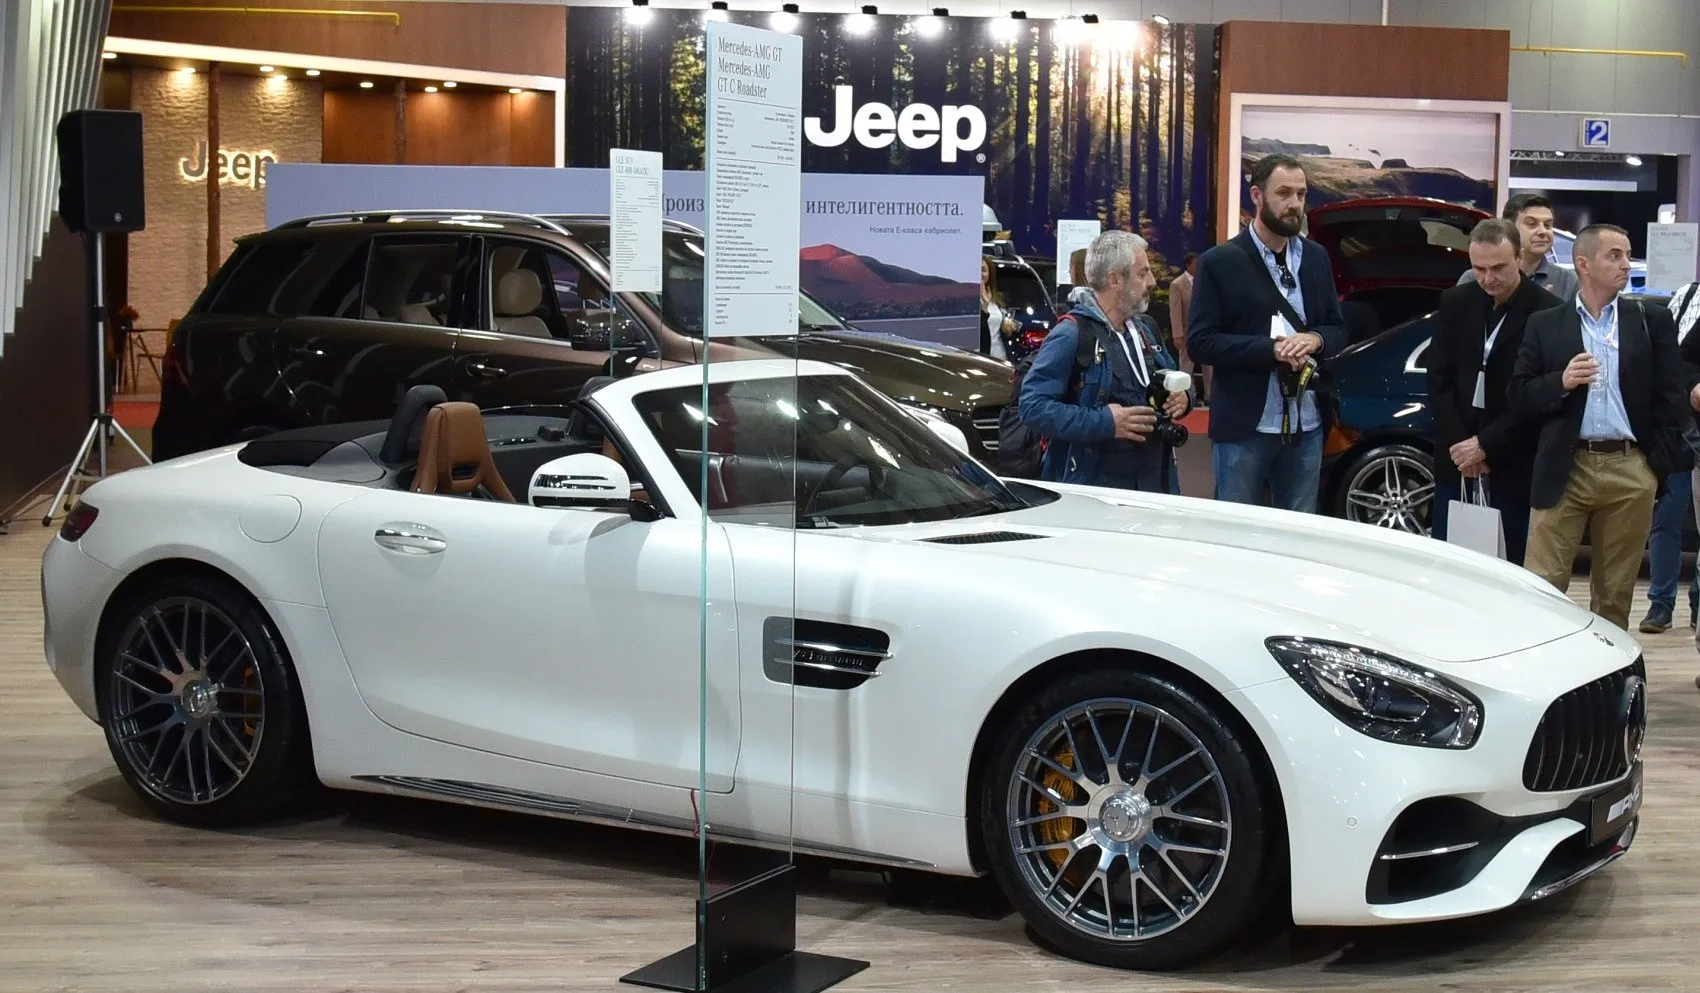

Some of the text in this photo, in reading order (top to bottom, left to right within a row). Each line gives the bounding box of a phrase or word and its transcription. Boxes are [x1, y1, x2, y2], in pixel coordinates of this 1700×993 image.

[718, 37, 782, 61] Mercedes-AMG GT
[718, 57, 770, 79] Mercedes-AMG
[717, 77, 767, 98] GT C Roadster
[804, 85, 987, 162] Jeep
[1590, 121, 1607, 145] 2
[806, 200, 964, 216] интелигентността.
[870, 226, 894, 234] Новата
